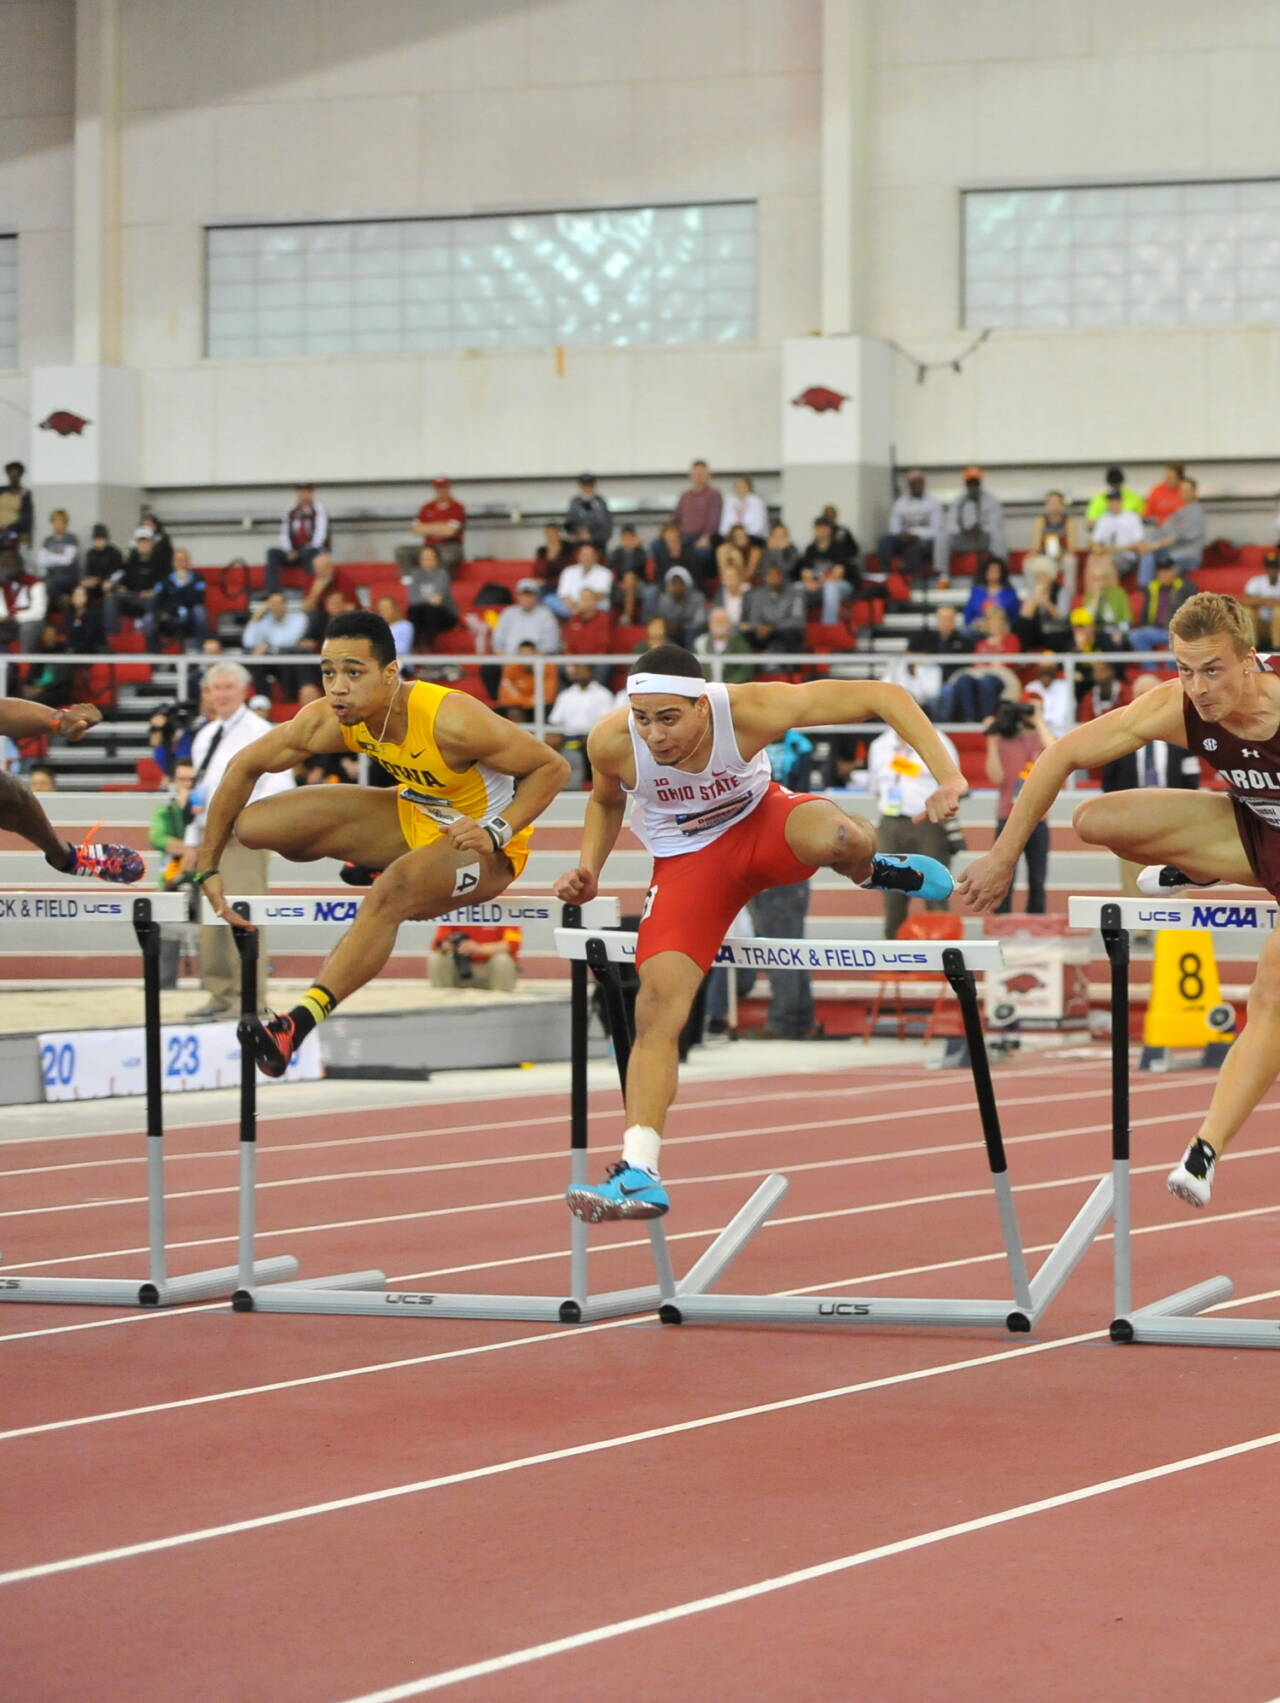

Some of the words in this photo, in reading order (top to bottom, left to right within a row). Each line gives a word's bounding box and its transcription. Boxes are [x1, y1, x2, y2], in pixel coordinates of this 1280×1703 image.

[656, 785, 695, 802] OHIO
[699, 774, 741, 801] STATE
[456, 872, 477, 892] 4
[21, 899, 31, 918] &
[36, 899, 78, 918] FIELD
[84, 903, 122, 914] UCS
[265, 907, 305, 917] UCS
[314, 902, 358, 921] NCA
[457, 904, 503, 922] FIELD
[508, 908, 550, 919] UCS
[1138, 911, 1182, 922] UCS
[1192, 906, 1258, 928] NCAA
[742, 948, 802, 966] TRACK
[810, 949, 822, 967] &
[826, 949, 876, 967] FIELD
[883, 953, 928, 964] UCS
[1178, 952, 1205, 1001] 8
[42, 1043, 75, 1086] 20
[166, 1035, 200, 1076] 23
[385, 1293, 437, 1305] UCS
[818, 1303, 871, 1315] UCS
